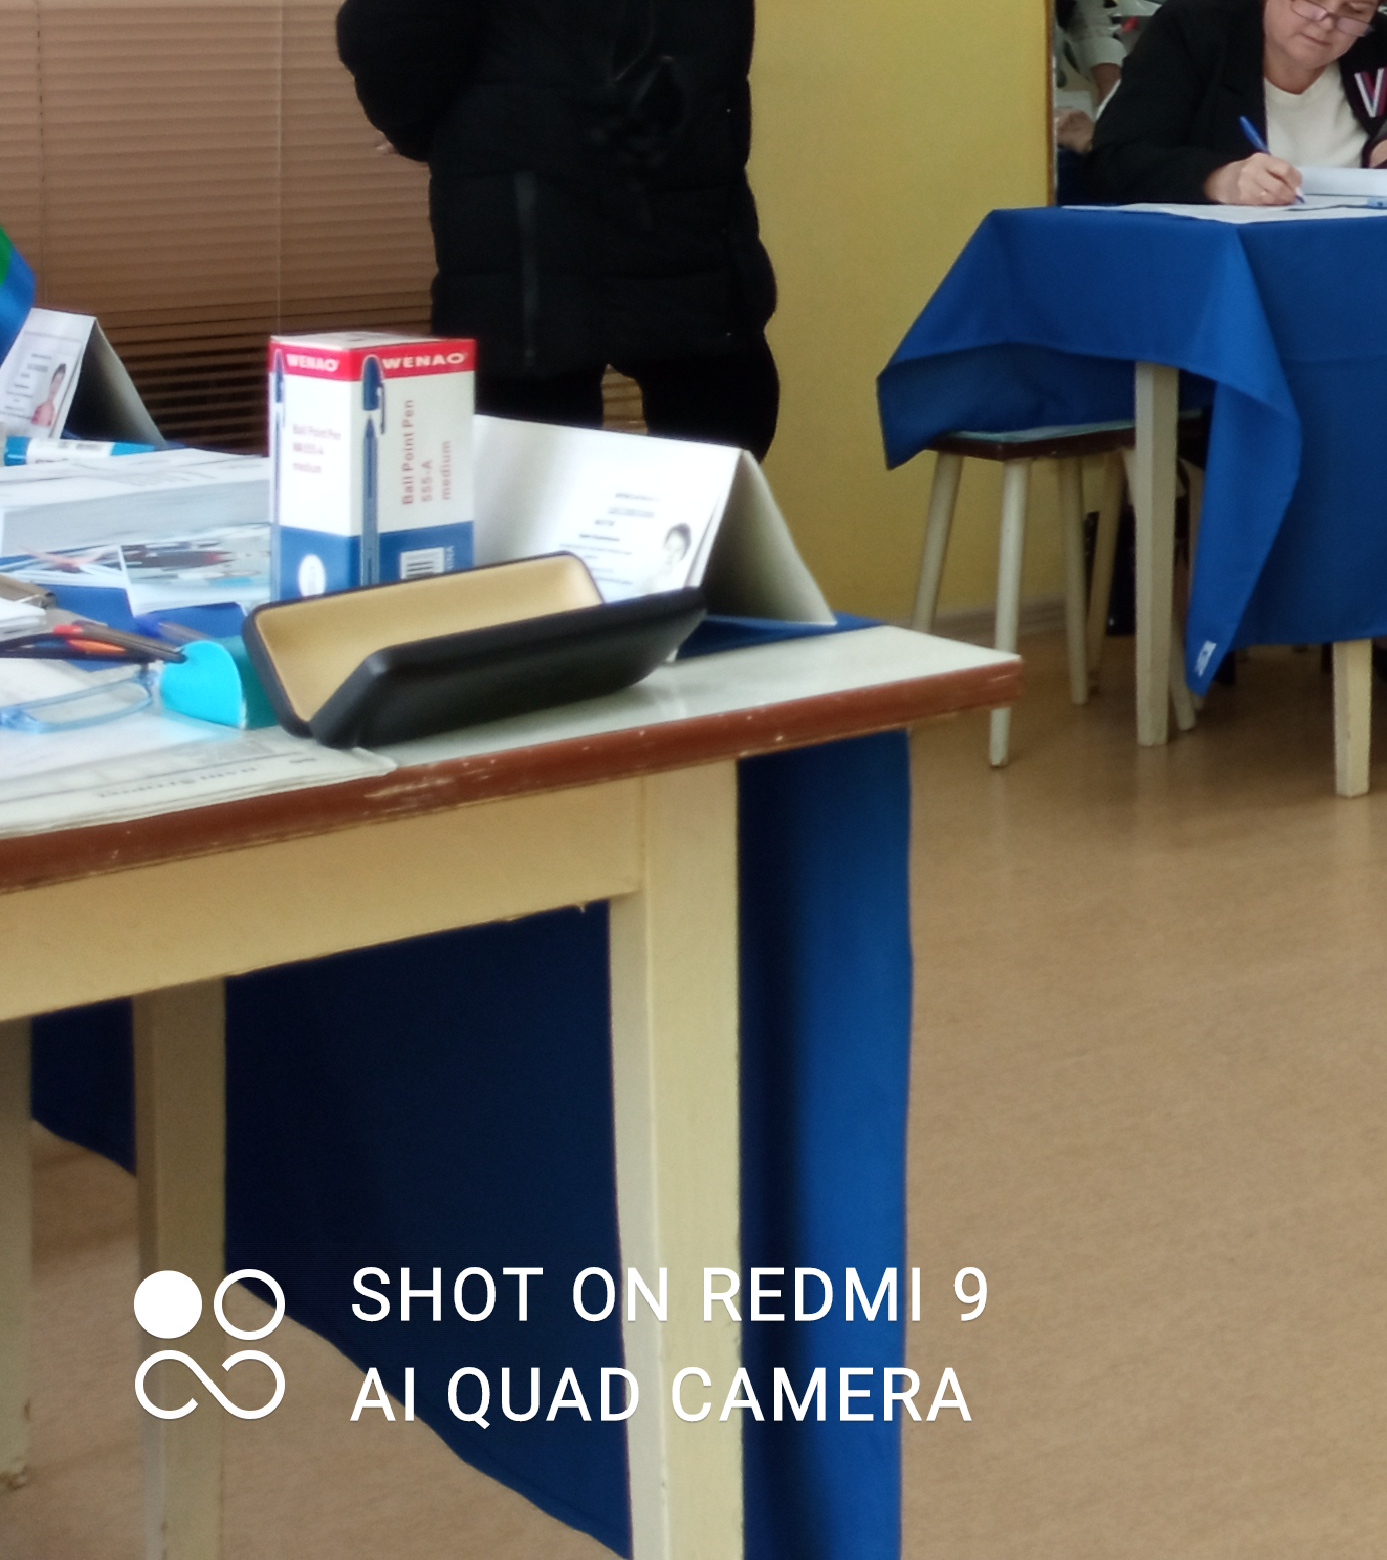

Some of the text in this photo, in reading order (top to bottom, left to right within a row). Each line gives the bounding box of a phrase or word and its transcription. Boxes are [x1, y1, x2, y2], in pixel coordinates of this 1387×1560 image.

[286, 353, 340, 373] WENAO
[381, 352, 467, 370] WENAO
[401, 399, 415, 506] Ball Point Pen
[440, 440, 454, 501] medium
